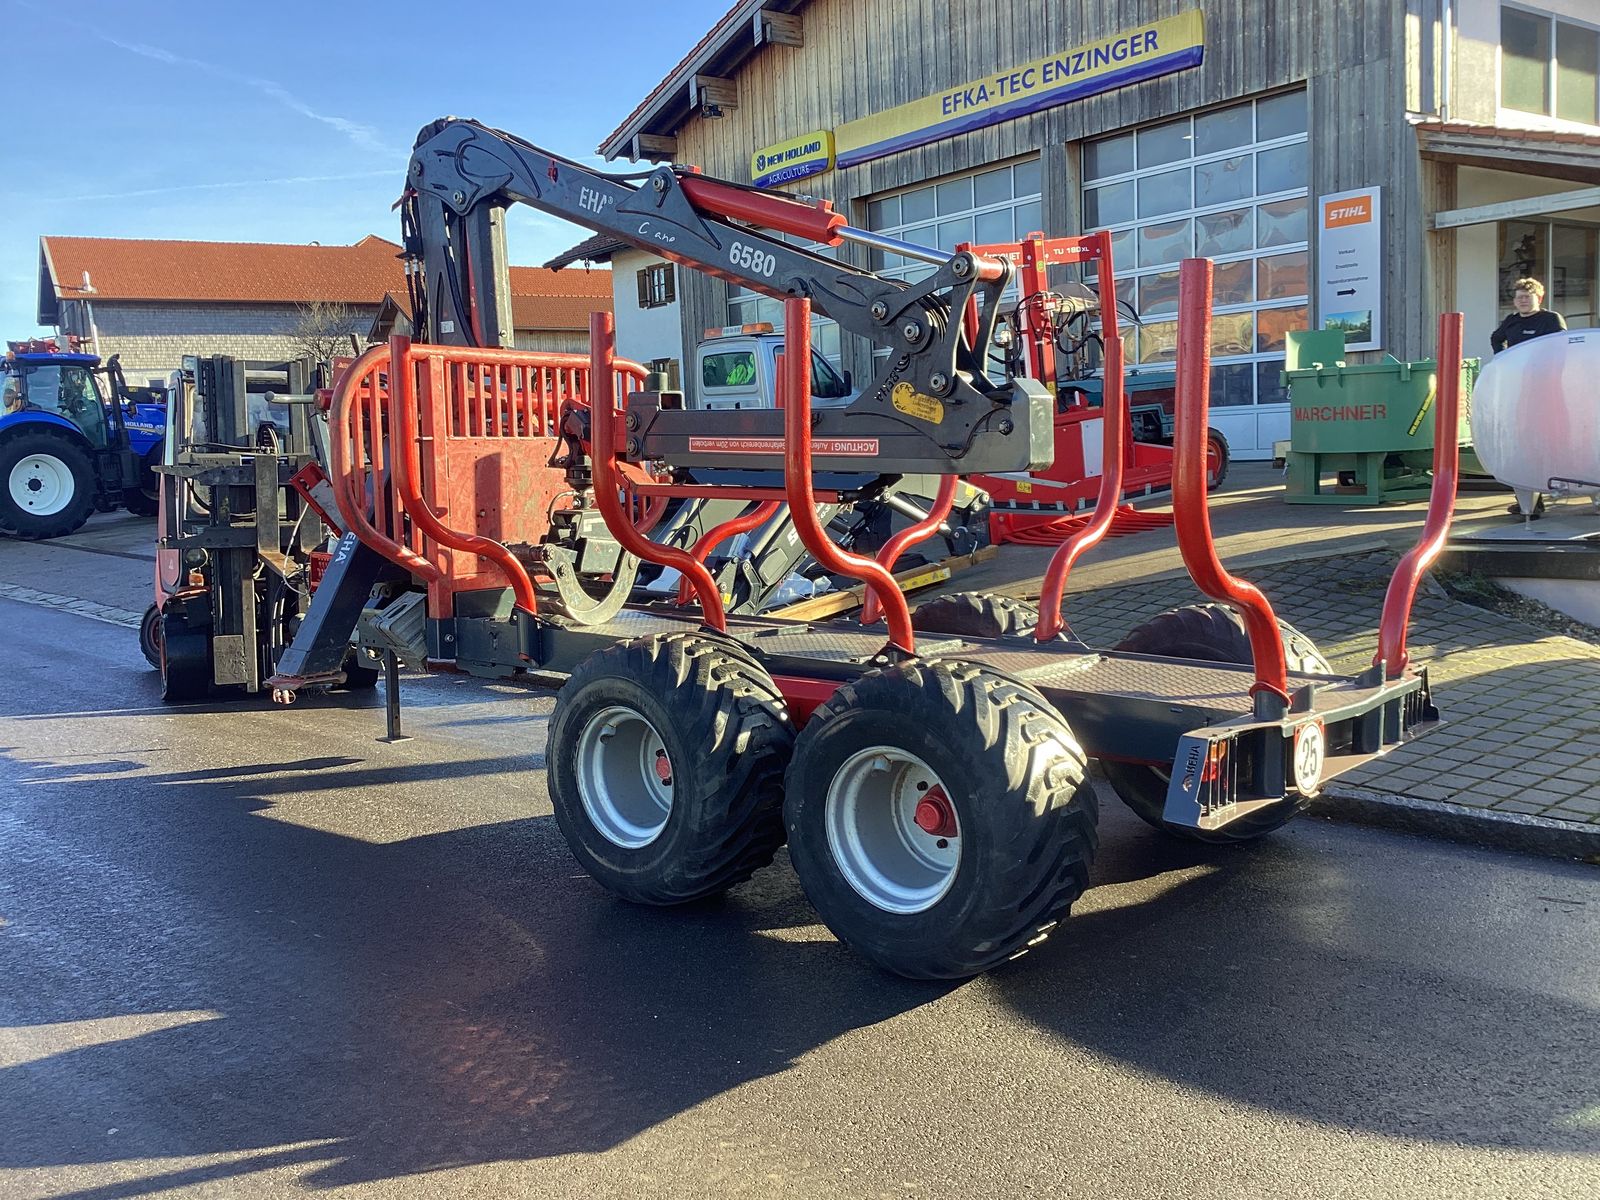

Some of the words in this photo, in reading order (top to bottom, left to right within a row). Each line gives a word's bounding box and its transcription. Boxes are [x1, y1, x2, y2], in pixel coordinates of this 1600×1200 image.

[942, 68, 1035, 115] EFKA-TEC
[1042, 30, 1159, 84] ENZINGER
[767, 152, 784, 167] NEW
[785, 141, 821, 161] HOLLAND
[769, 165, 811, 184] AGRICULTURE
[1329, 205, 1367, 220] STIHL
[729, 241, 776, 278] 6580
[1295, 404, 1386, 421] MARCHNER
[692, 440, 715, 448] verboten
[831, 442, 875, 452] ACHTUNG!
[1302, 734, 1318, 778] 25
